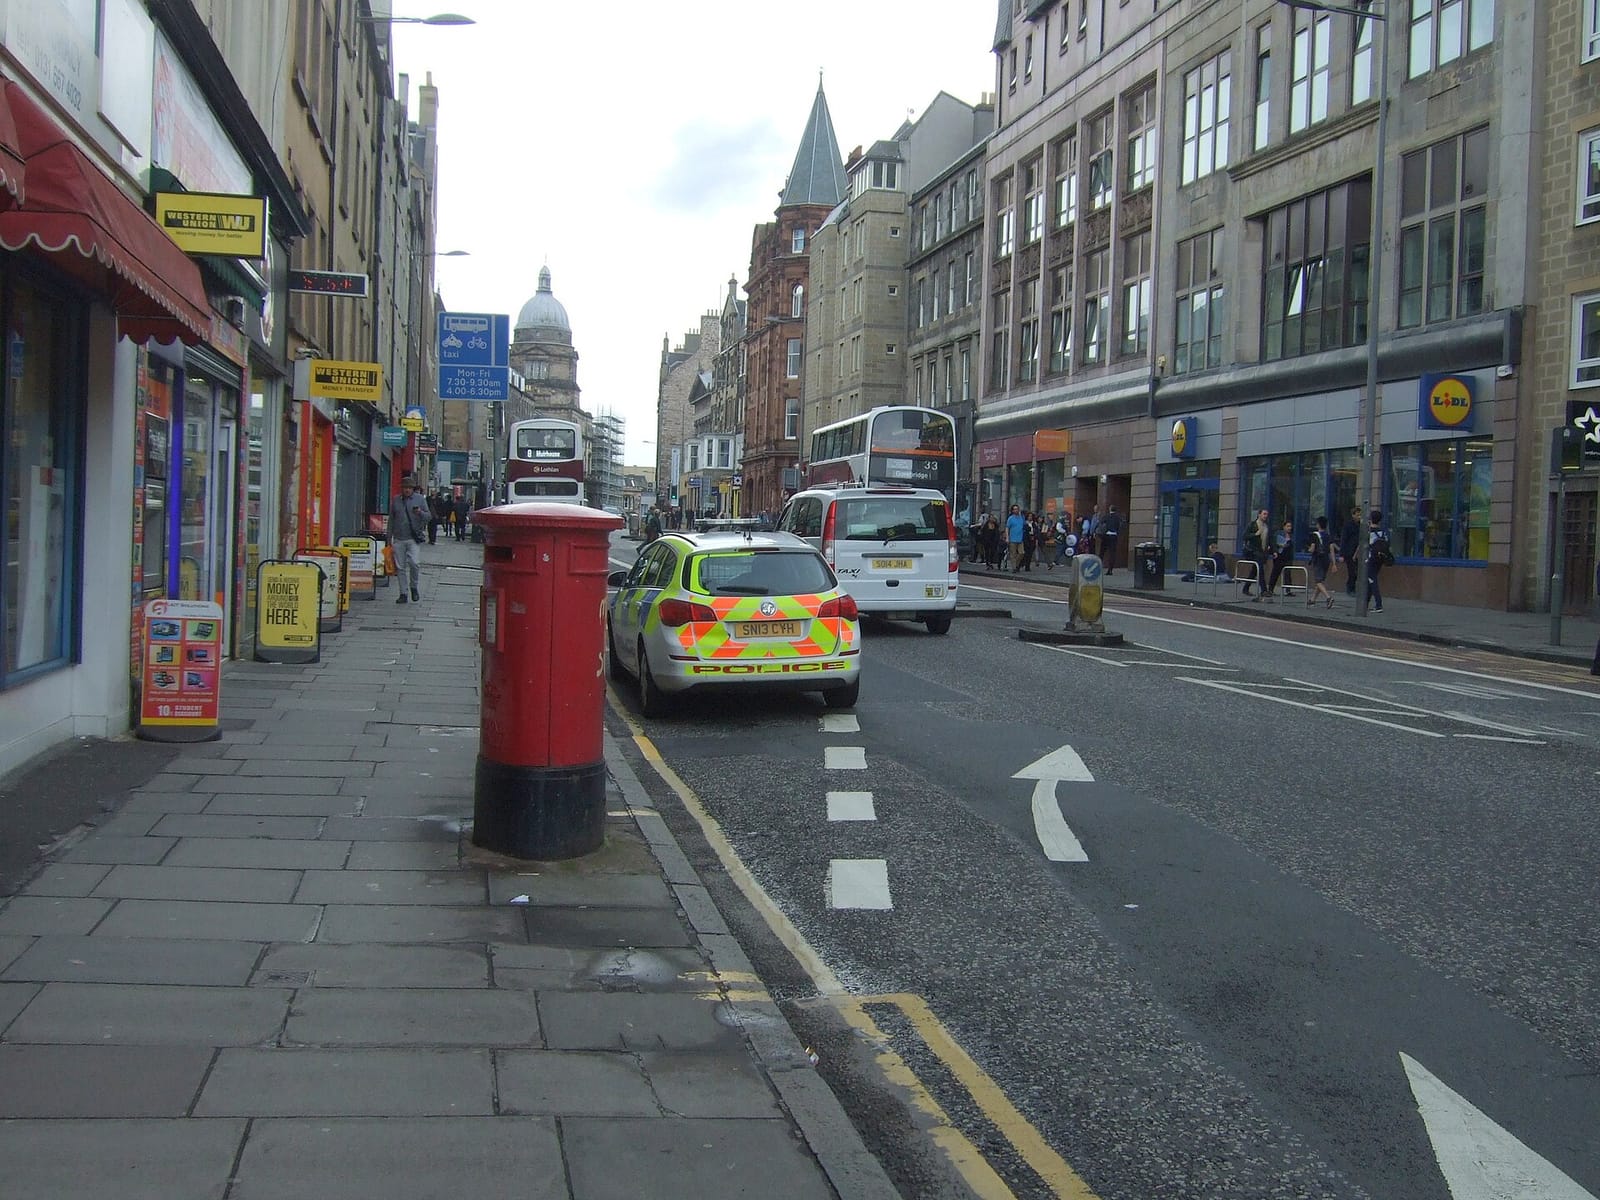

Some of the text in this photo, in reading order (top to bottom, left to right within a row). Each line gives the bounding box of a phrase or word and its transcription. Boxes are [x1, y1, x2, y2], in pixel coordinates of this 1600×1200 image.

[167, 211, 250, 230] WESTERN WU
[182, 220, 217, 228] UNION
[443, 350, 459, 358] taxi
[315, 368, 367, 378] WESTERN
[331, 376, 367, 385] UNION
[447, 378, 501, 387] 7.30-9.30am
[446, 387, 502, 397] 4.00-6.30pm
[924, 461, 938, 471] 33
[266, 583, 300, 595] MONEY
[266, 608, 298, 625] HERE
[742, 622, 795, 635] SN13 CYH
[692, 660, 845, 674] POLICE
